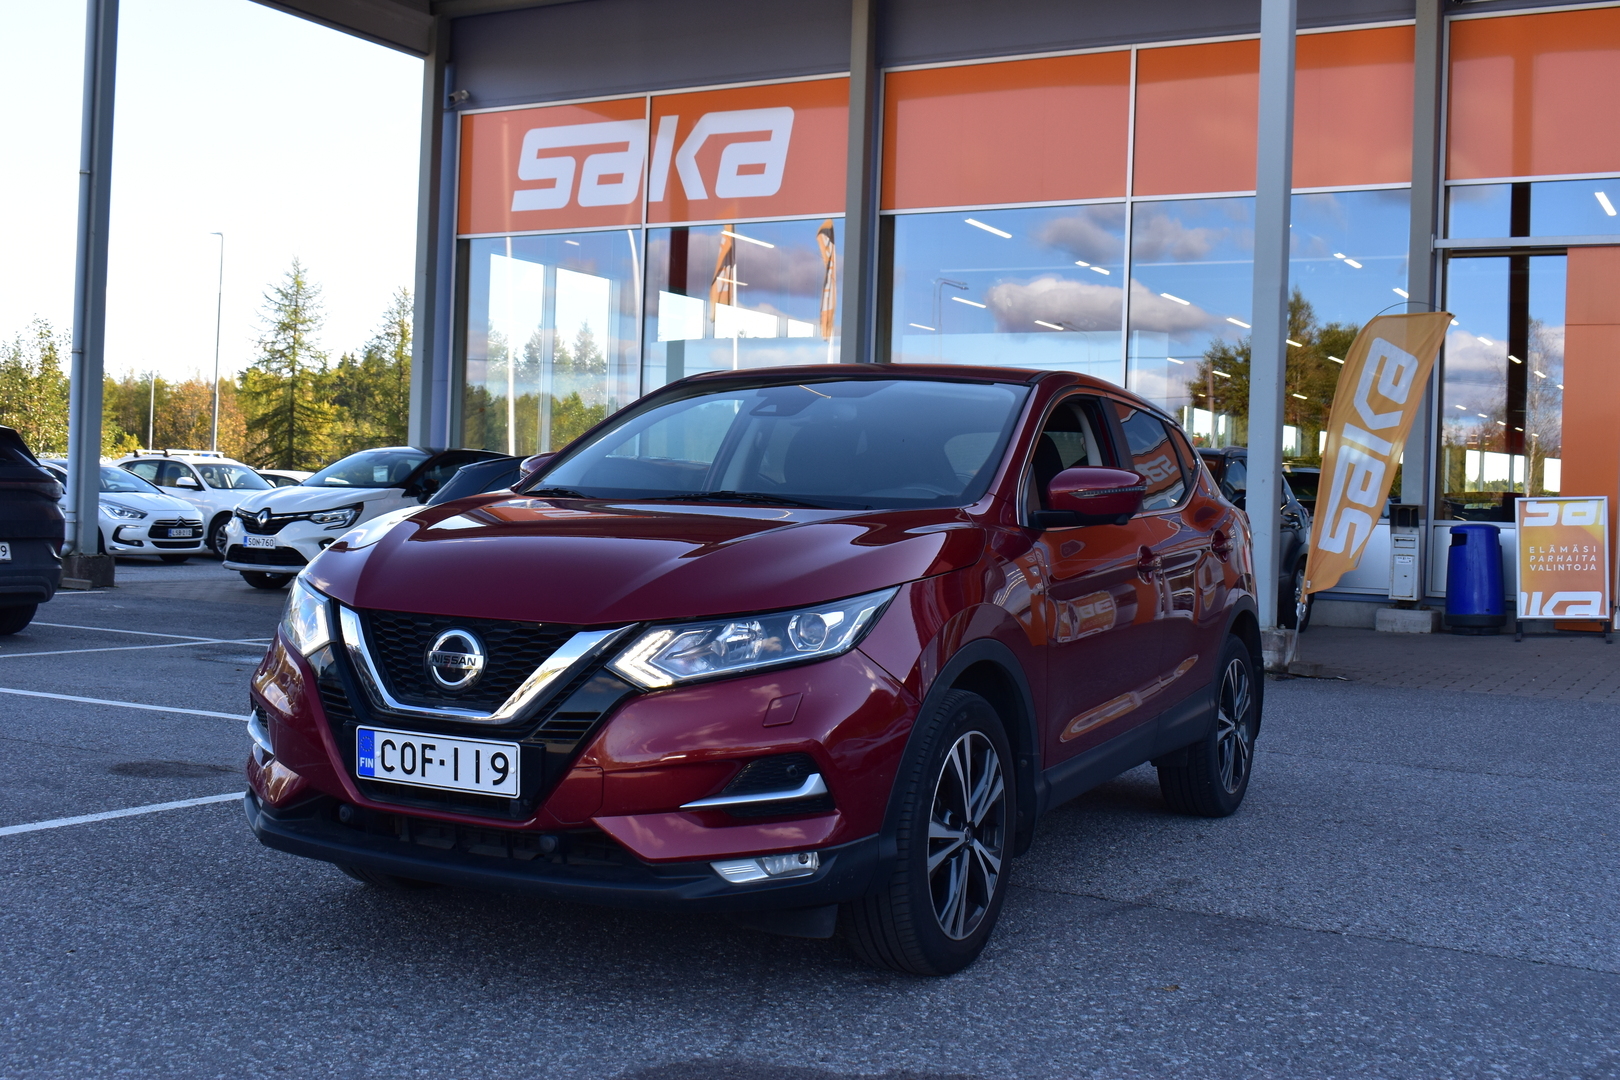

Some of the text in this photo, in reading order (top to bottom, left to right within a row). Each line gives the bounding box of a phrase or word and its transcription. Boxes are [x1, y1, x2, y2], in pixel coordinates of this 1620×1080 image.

[248, 537, 274, 547] SON-760
[1529, 544, 1597, 554] ELÄMÄSI
[1529, 555, 1597, 563] PARHAITA
[1529, 563, 1597, 572] VALINTOJA
[432, 653, 477, 667] NISSAN
[360, 757, 374, 769] FIN
[380, 739, 510, 786] COF-119
